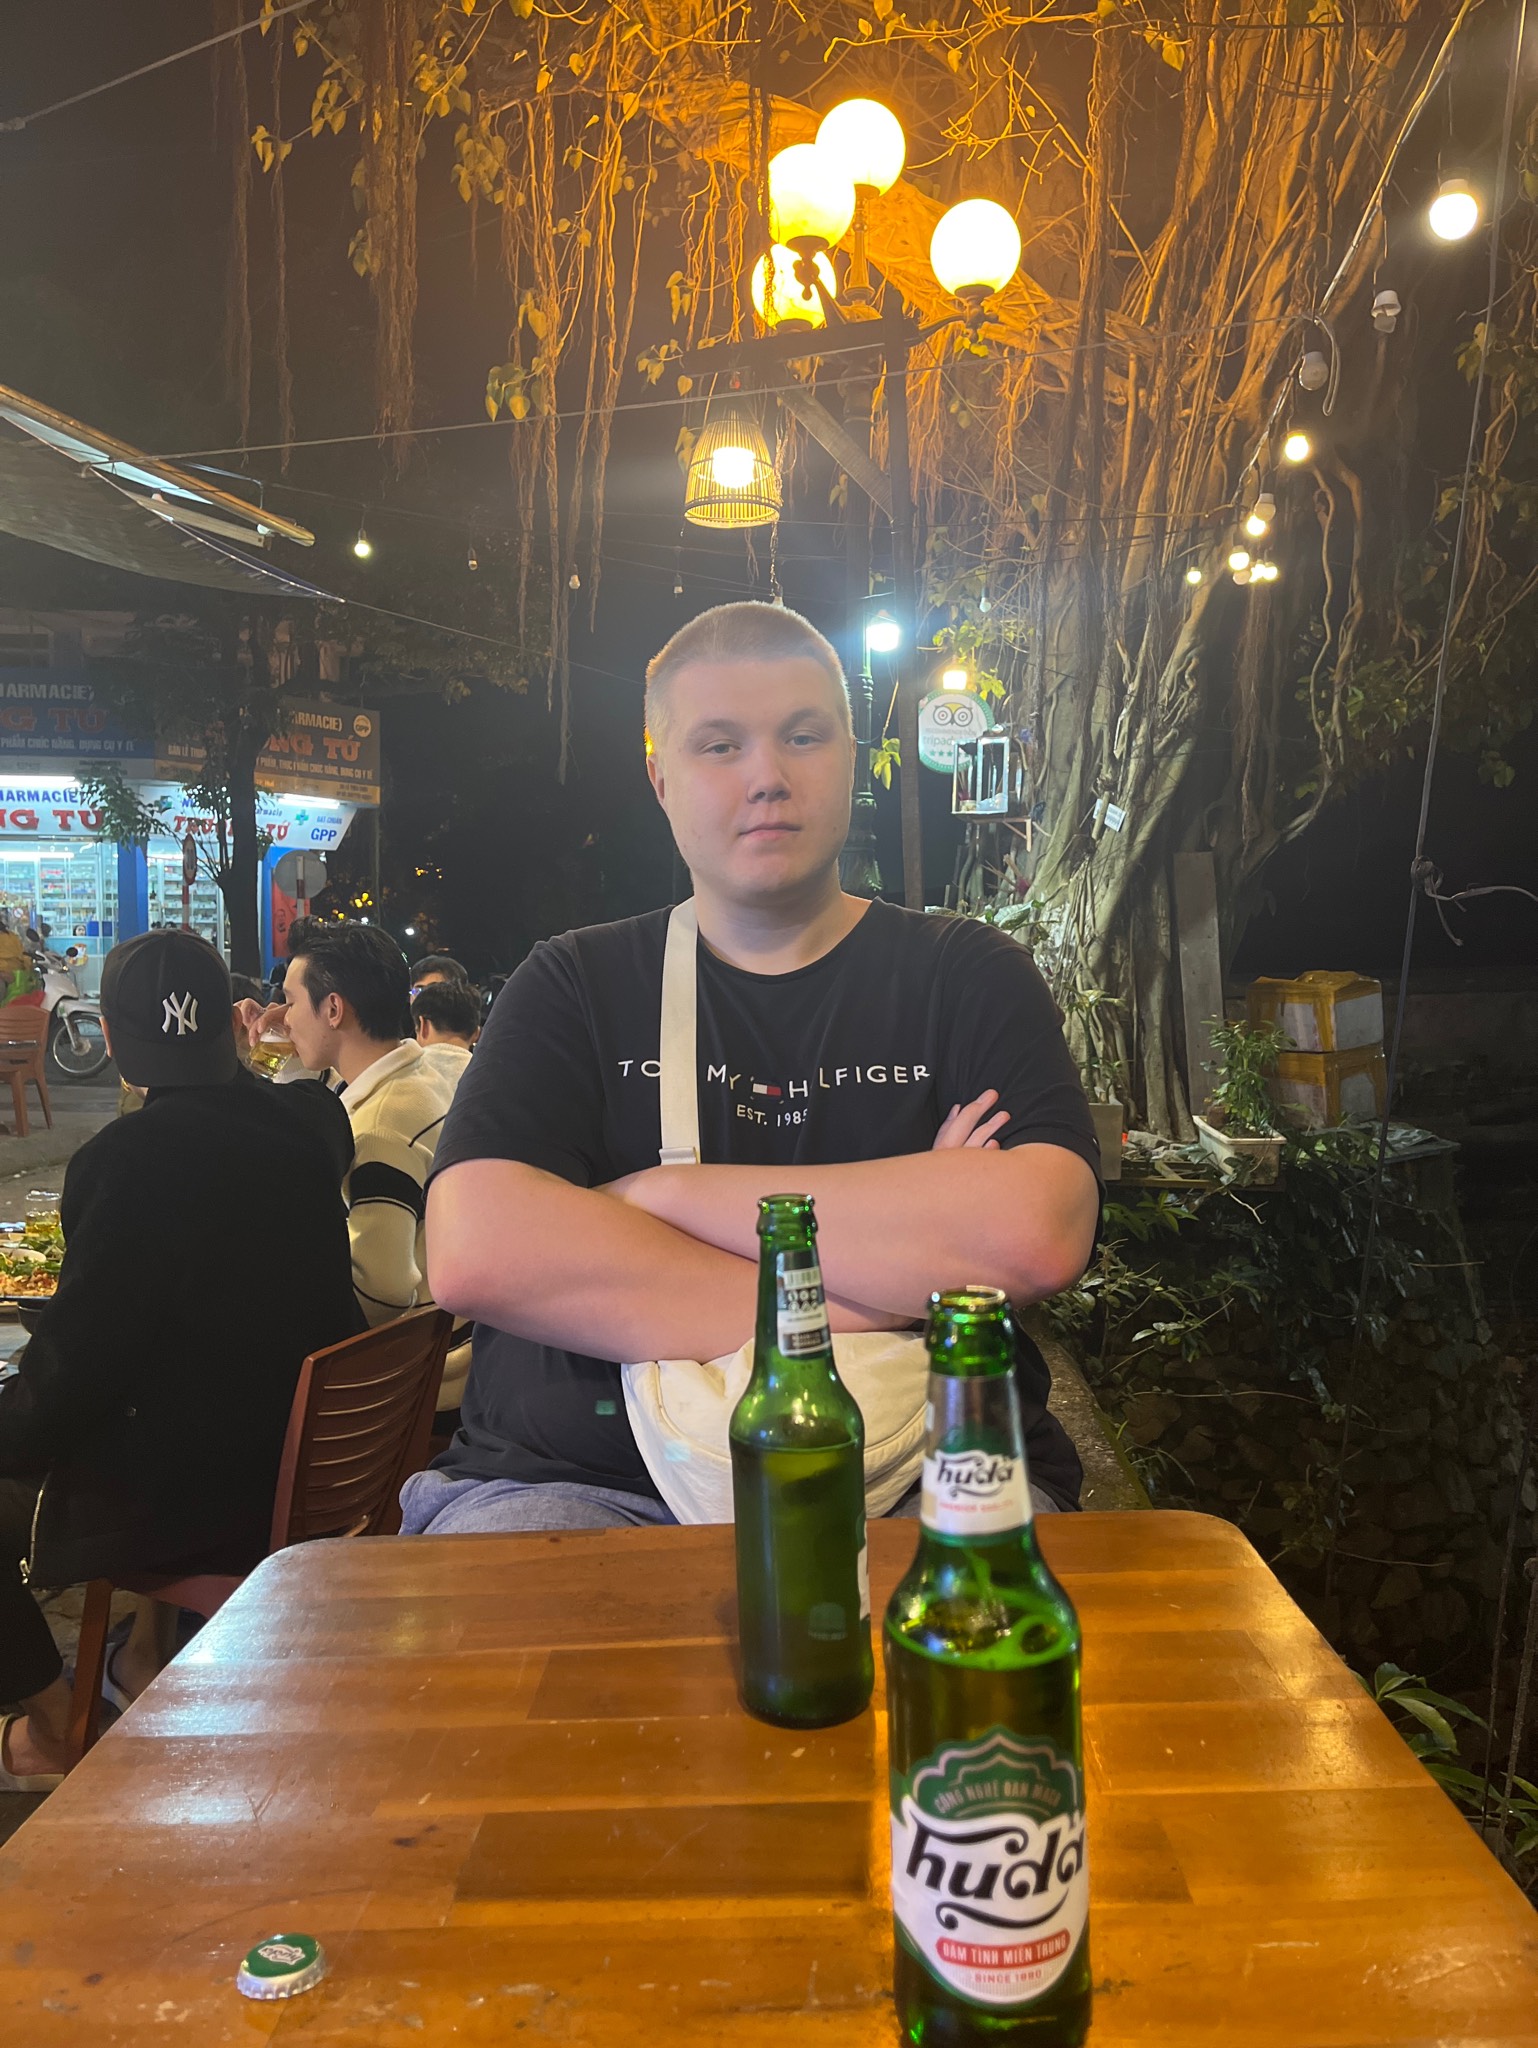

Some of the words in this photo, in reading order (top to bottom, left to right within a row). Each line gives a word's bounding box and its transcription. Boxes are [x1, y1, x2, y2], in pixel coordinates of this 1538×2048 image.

[323, 734, 361, 762] TÚ
[311, 828, 338, 842] GPP
[162, 991, 199, 1035] NY
[618, 1060, 741, 1090] TOMY
[789, 1065, 931, 1098] HLFIGER
[737, 1104, 767, 1126] EST.
[937, 1456, 1013, 1487] huda
[906, 1810, 1085, 1900] huda
[1036, 1933, 1067, 1959] TRUNG
[974, 1972, 1011, 1984] SINCE
